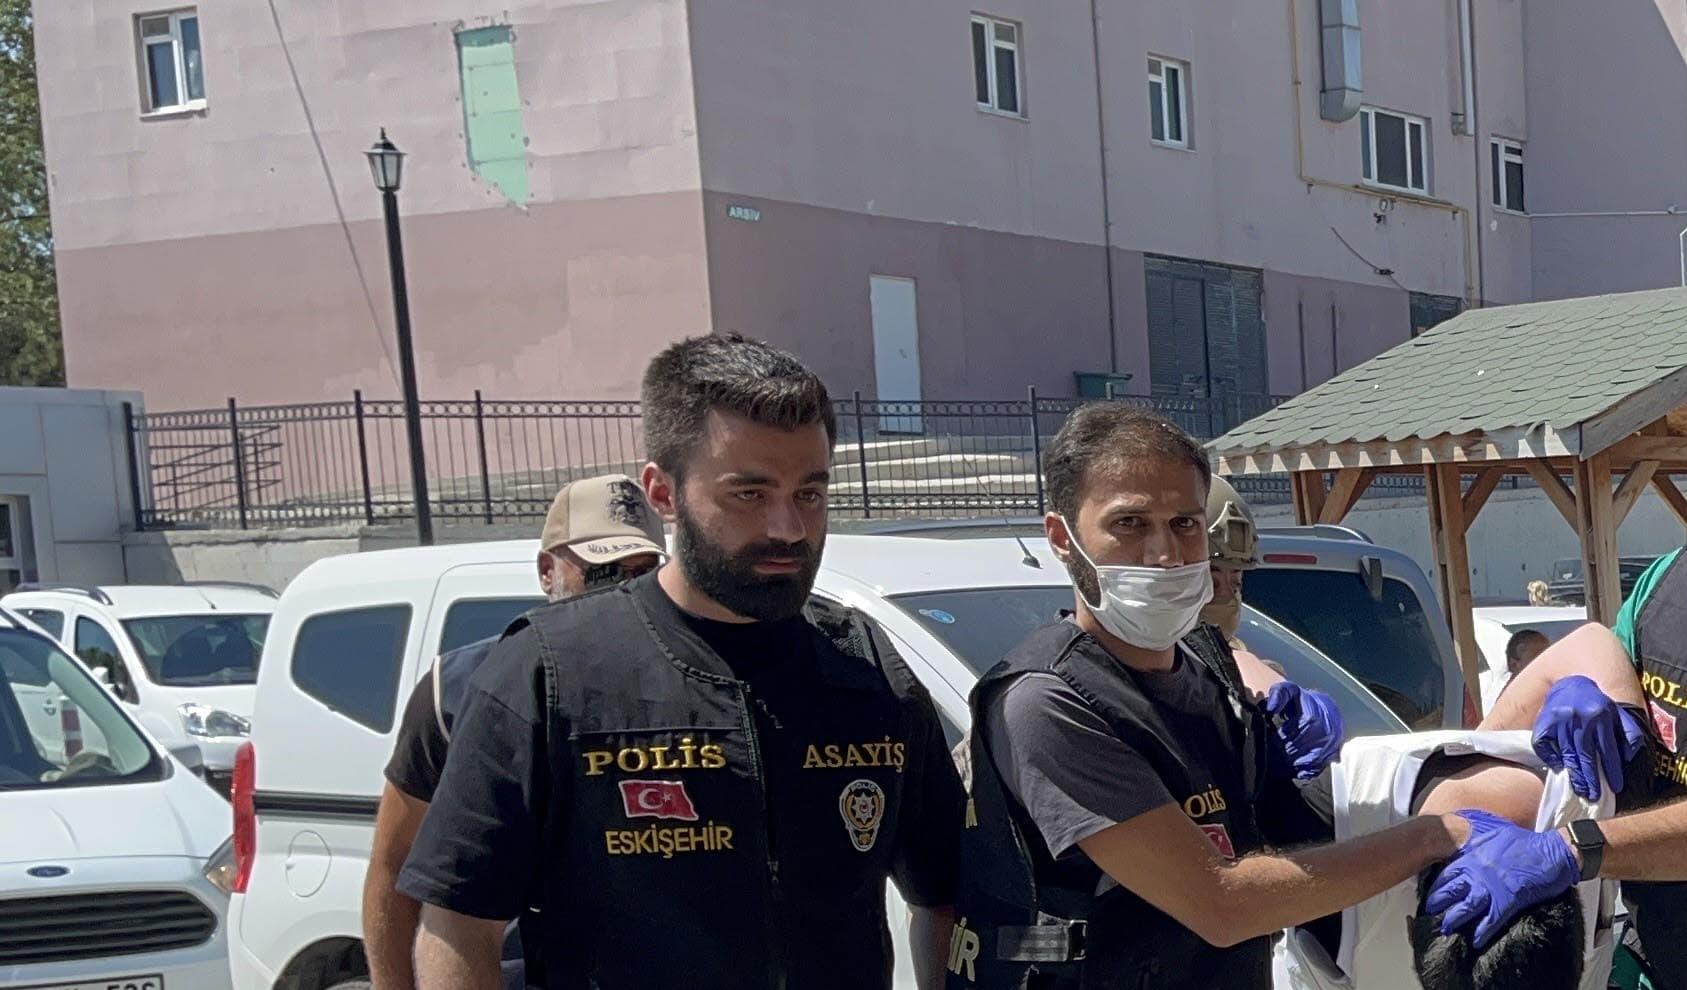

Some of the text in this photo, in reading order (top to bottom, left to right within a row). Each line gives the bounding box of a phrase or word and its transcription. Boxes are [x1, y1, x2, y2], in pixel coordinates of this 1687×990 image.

[582, 738, 727, 776] POLİS
[802, 735, 905, 773] ASAYİŞ
[1184, 783, 1227, 818] OLİS
[605, 820, 735, 859] ESKİŞEHİR
